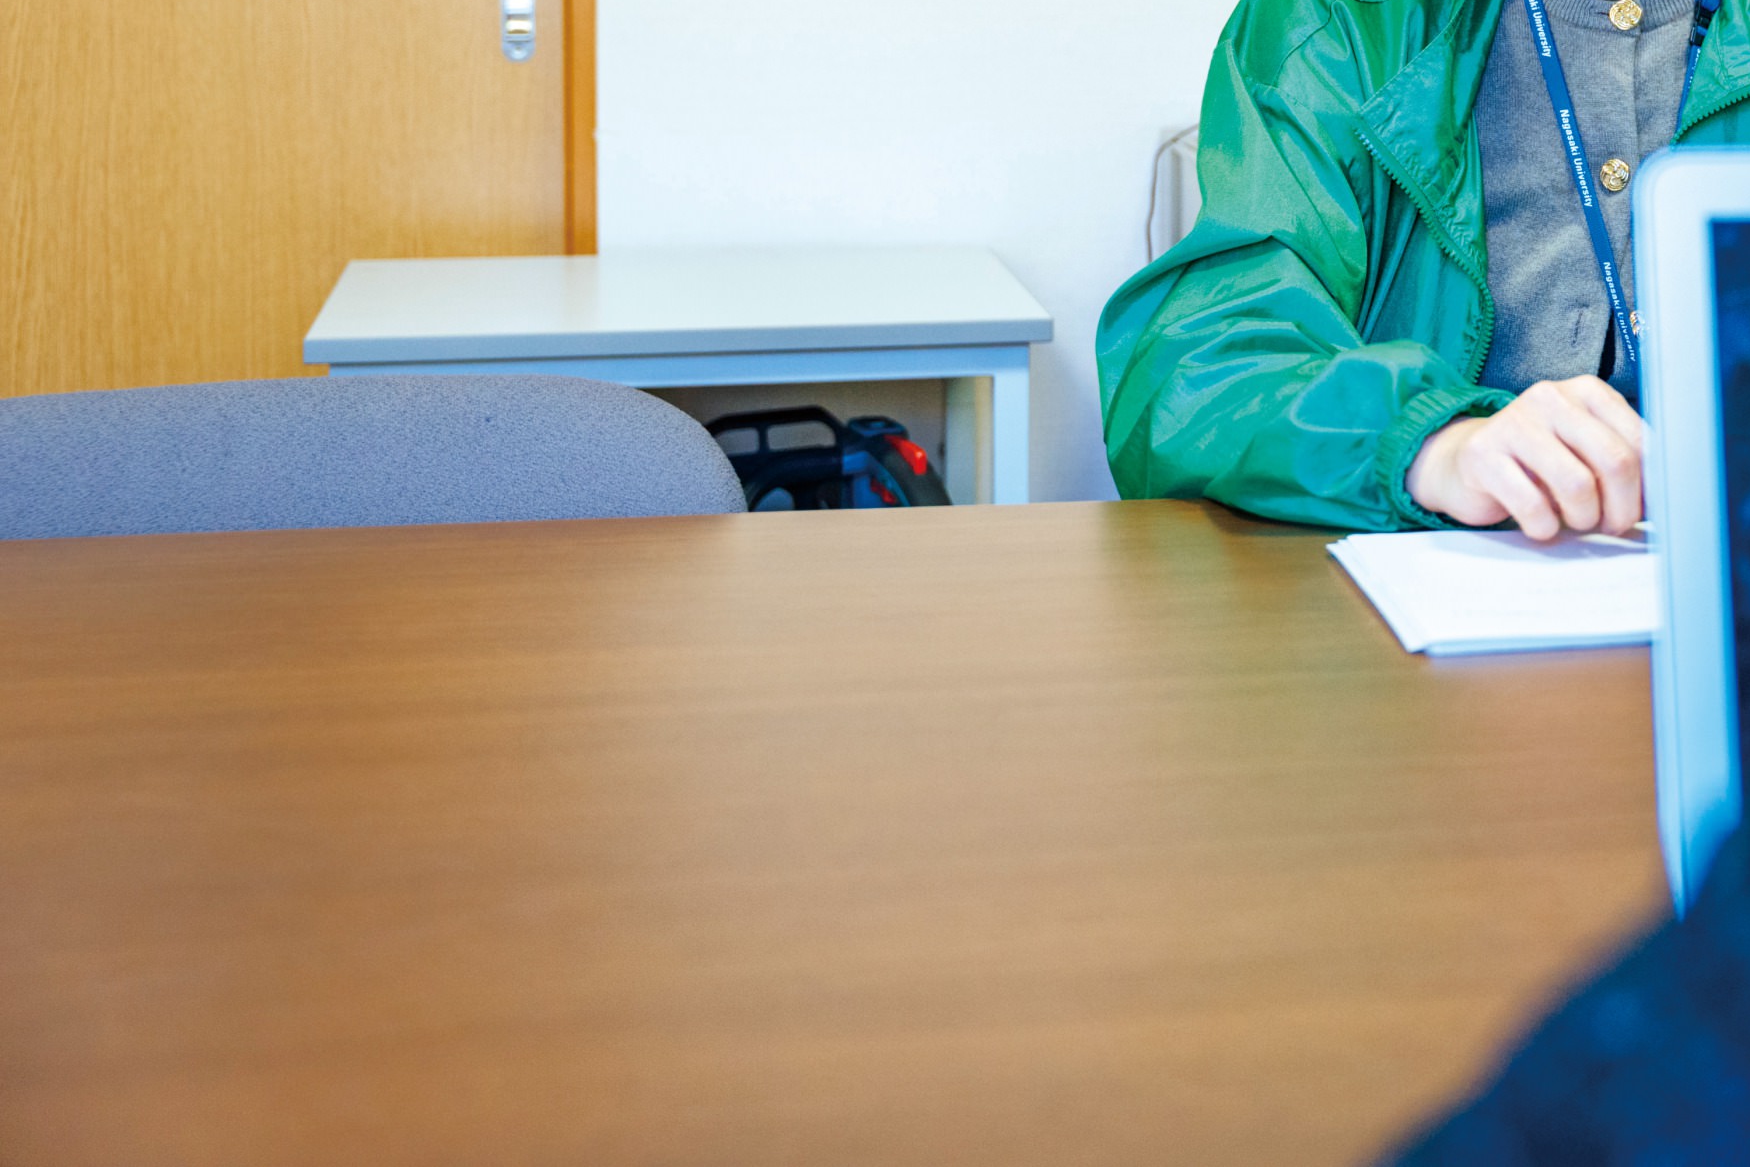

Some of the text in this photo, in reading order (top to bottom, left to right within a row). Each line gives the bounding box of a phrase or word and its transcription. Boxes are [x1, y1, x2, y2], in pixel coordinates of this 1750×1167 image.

[1532, 11, 1552, 58] University
[1560, 109, 1593, 207] Nagasaki University
[1603, 261, 1636, 362] Nagasaki University
